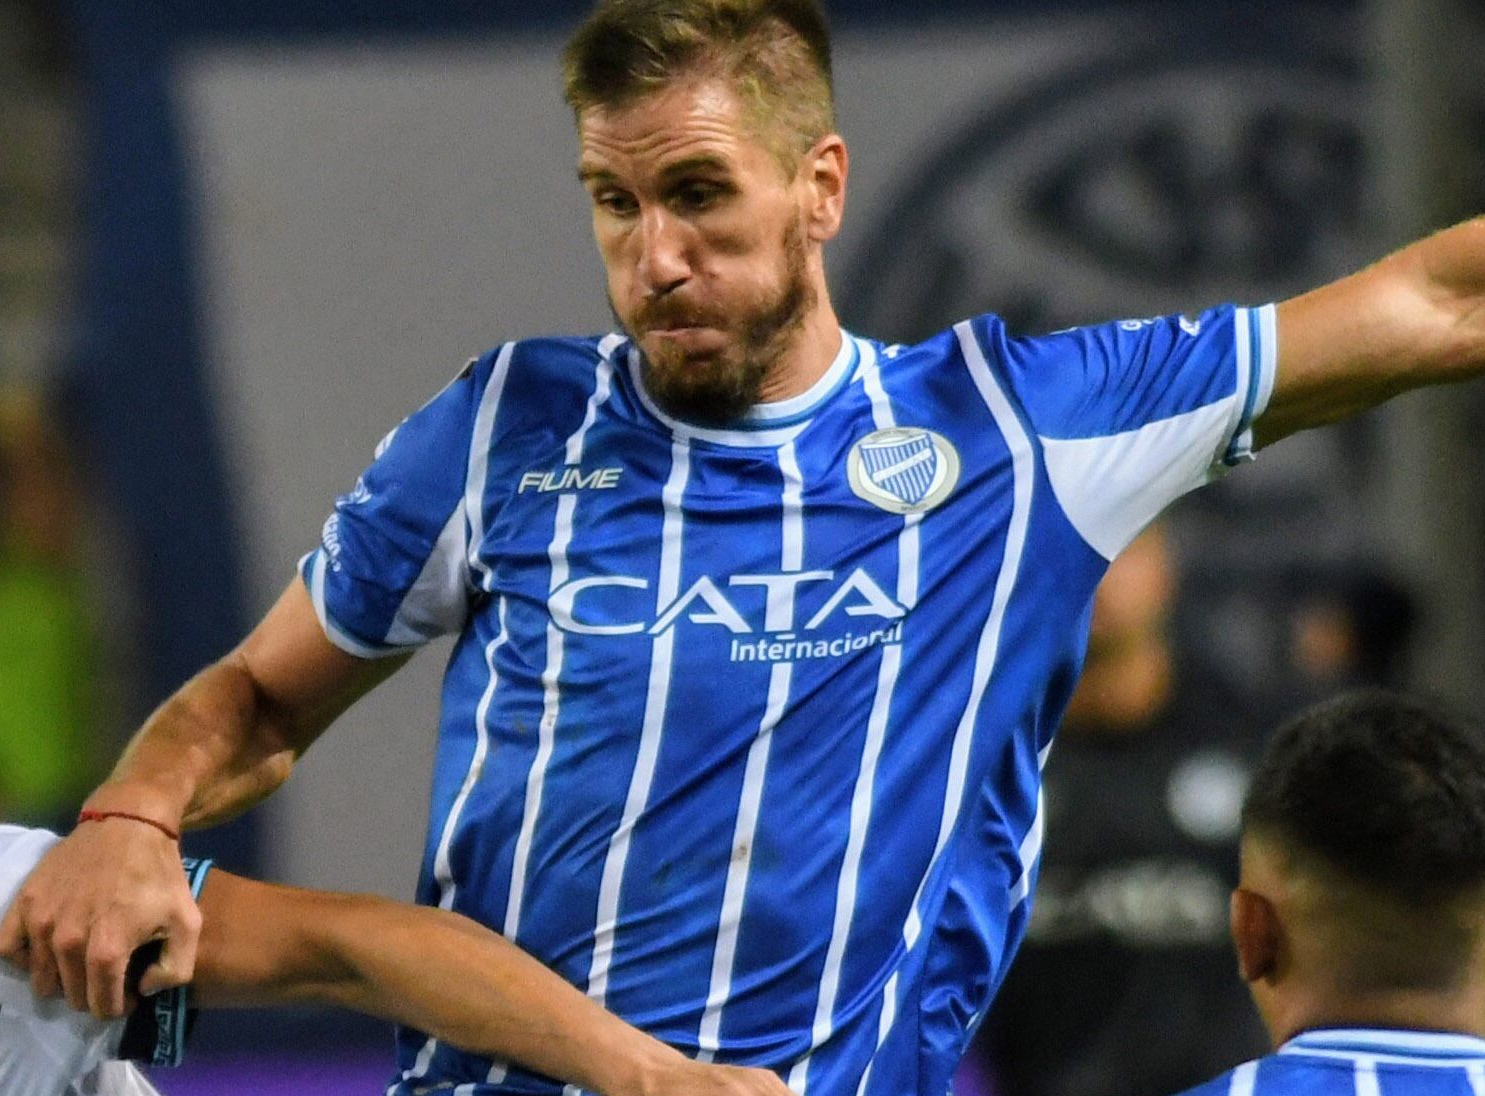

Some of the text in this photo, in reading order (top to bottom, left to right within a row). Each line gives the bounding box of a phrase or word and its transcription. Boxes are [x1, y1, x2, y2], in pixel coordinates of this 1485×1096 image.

[517, 467, 624, 495] FIUME
[547, 567, 908, 636] CATA
[729, 620, 903, 664] Internacional
